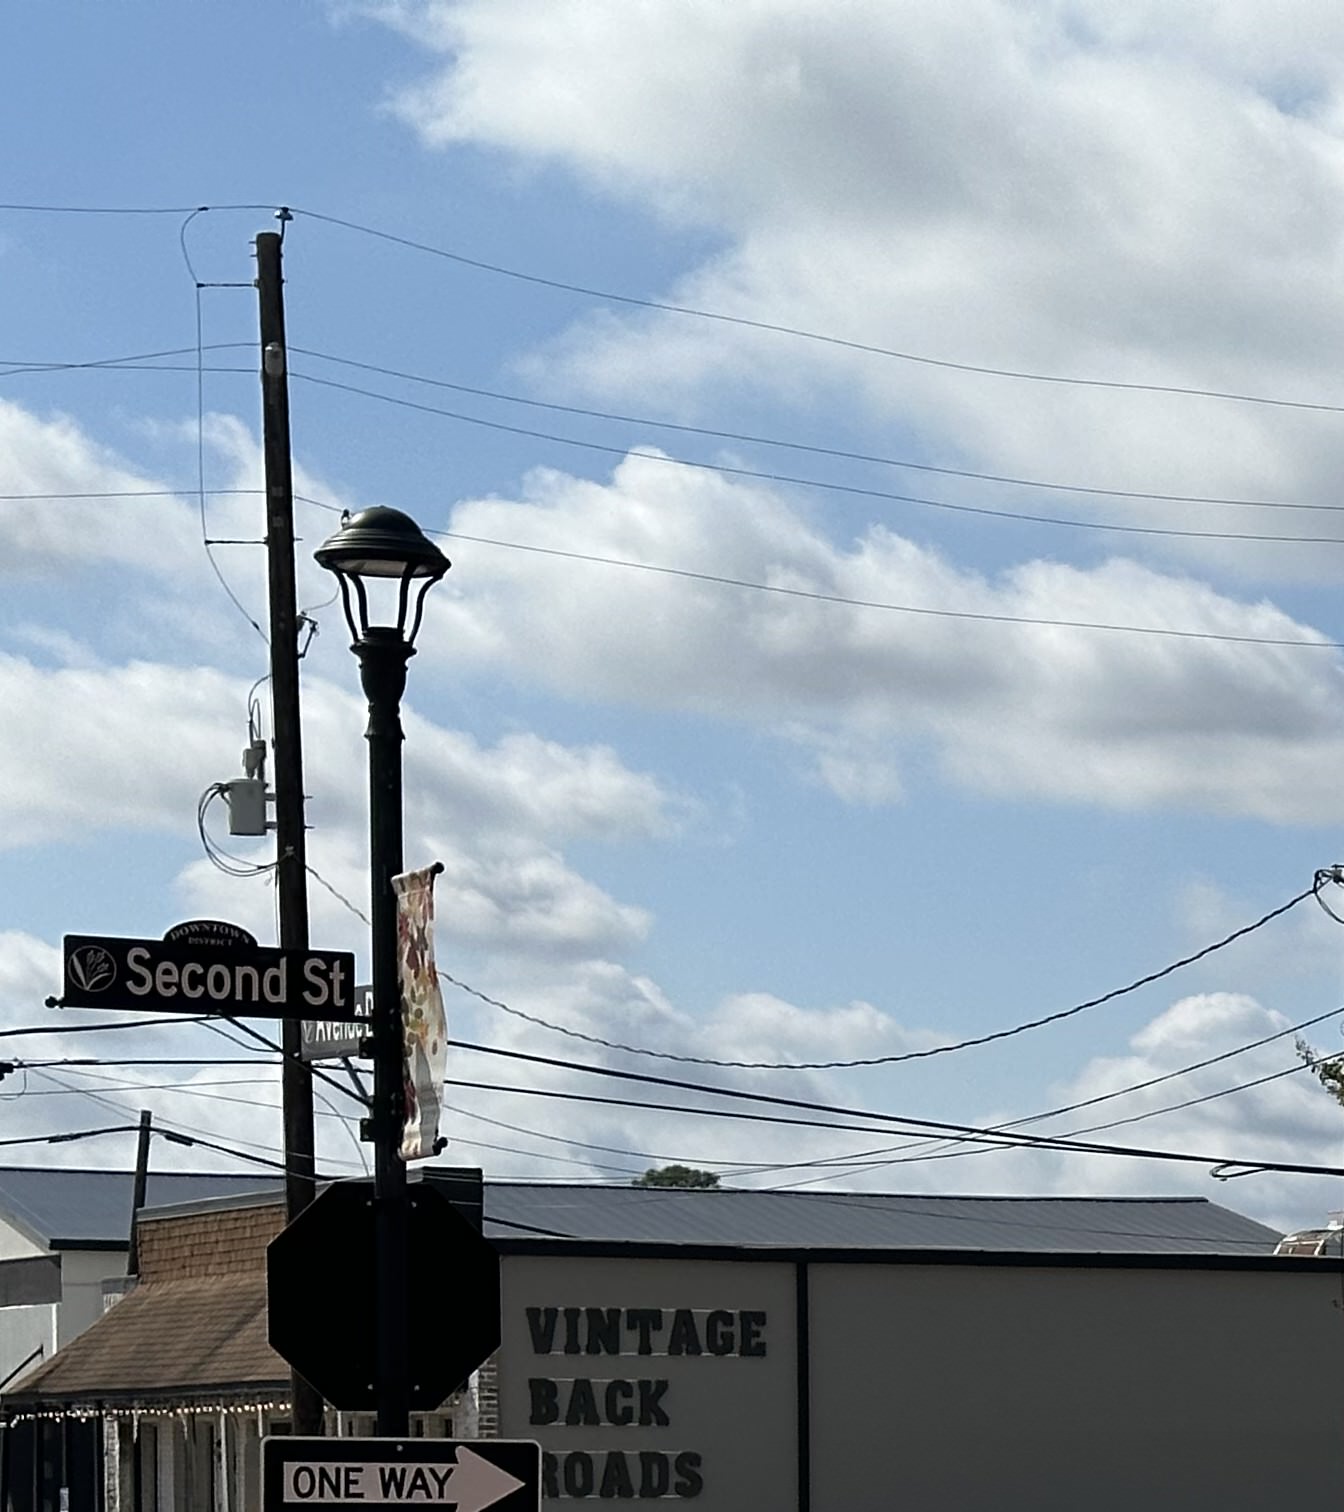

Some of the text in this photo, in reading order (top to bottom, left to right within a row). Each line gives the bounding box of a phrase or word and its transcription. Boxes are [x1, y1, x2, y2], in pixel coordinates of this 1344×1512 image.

[170, 922, 250, 944] DOWNTOWN
[188, 936, 232, 946] DISTRICT
[126, 947, 345, 1007] Second St
[526, 1307, 767, 1357] VINTAGE
[529, 1378, 670, 1426] BACK
[293, 1466, 454, 1499] ONE WAY
[543, 1451, 703, 1498] ROADS
